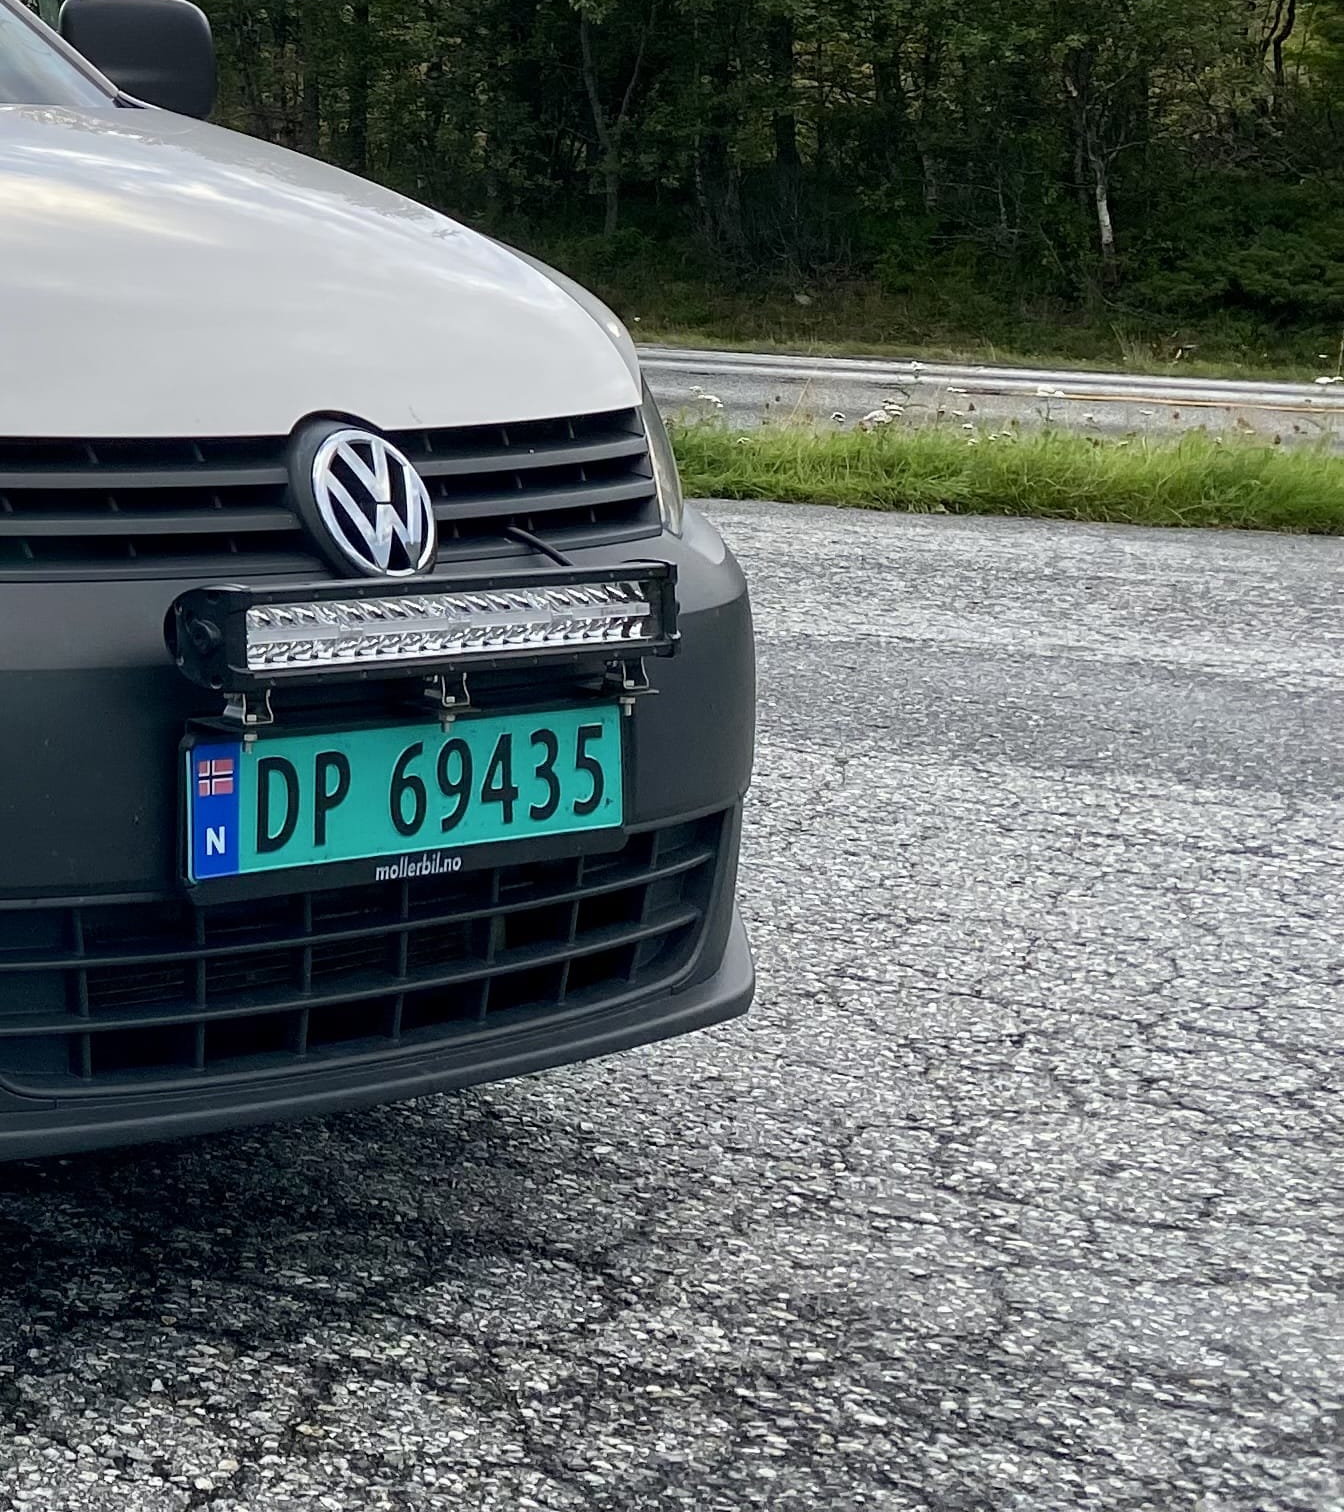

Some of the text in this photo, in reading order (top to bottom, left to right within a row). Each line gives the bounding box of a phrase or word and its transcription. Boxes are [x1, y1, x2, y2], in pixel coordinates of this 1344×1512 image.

[318, 433, 430, 574] VW
[256, 723, 605, 855] DP 69435
[205, 826, 226, 855] N
[375, 851, 462, 881] mollerbil.no
